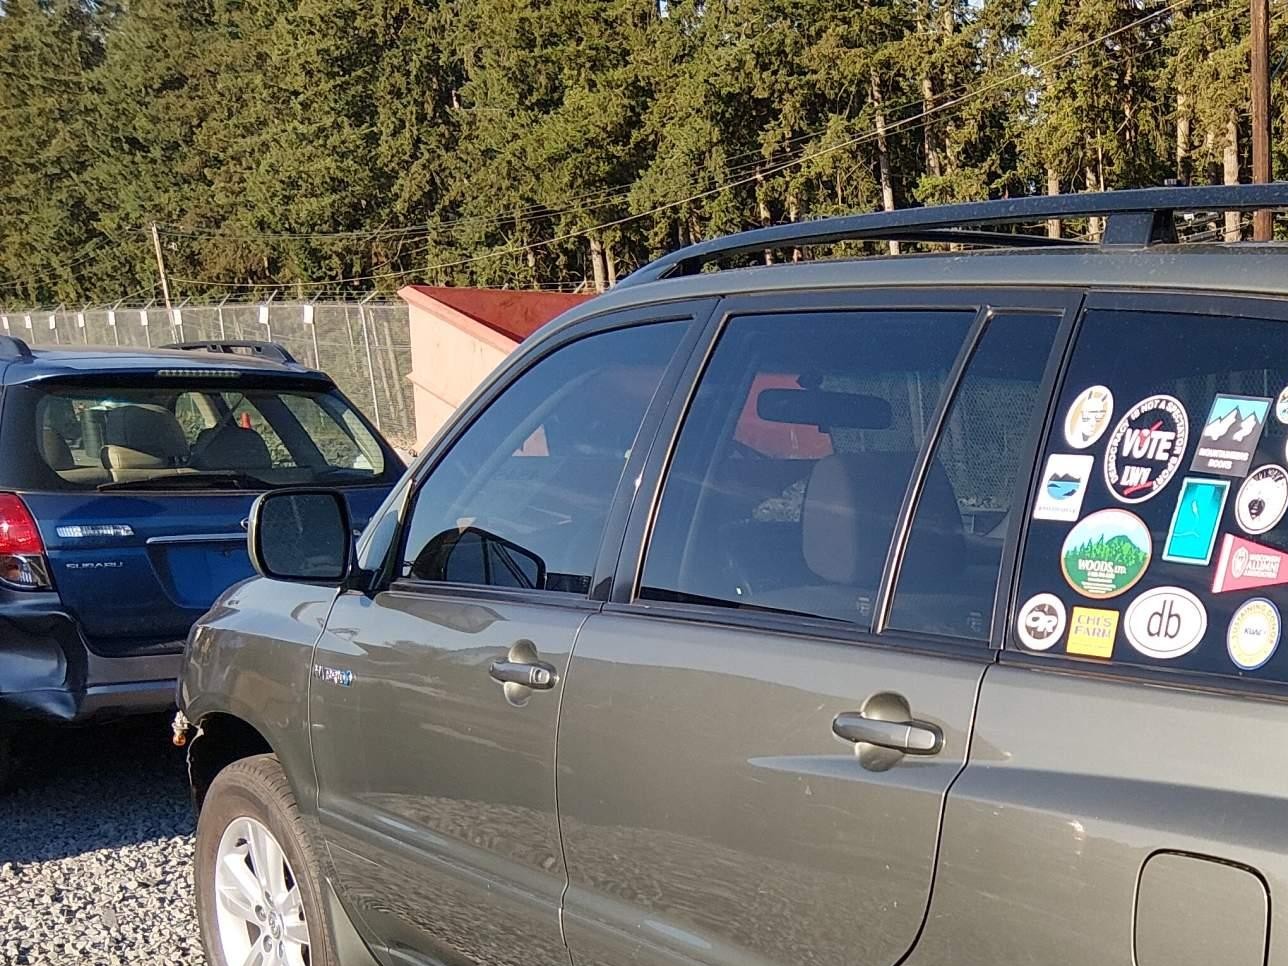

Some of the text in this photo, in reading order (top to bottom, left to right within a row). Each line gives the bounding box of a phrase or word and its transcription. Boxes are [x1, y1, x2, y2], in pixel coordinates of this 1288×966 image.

[1122, 428, 1176, 461] VOTE
[1074, 626, 1112, 639] FARM
[1147, 600, 1182, 639] db
